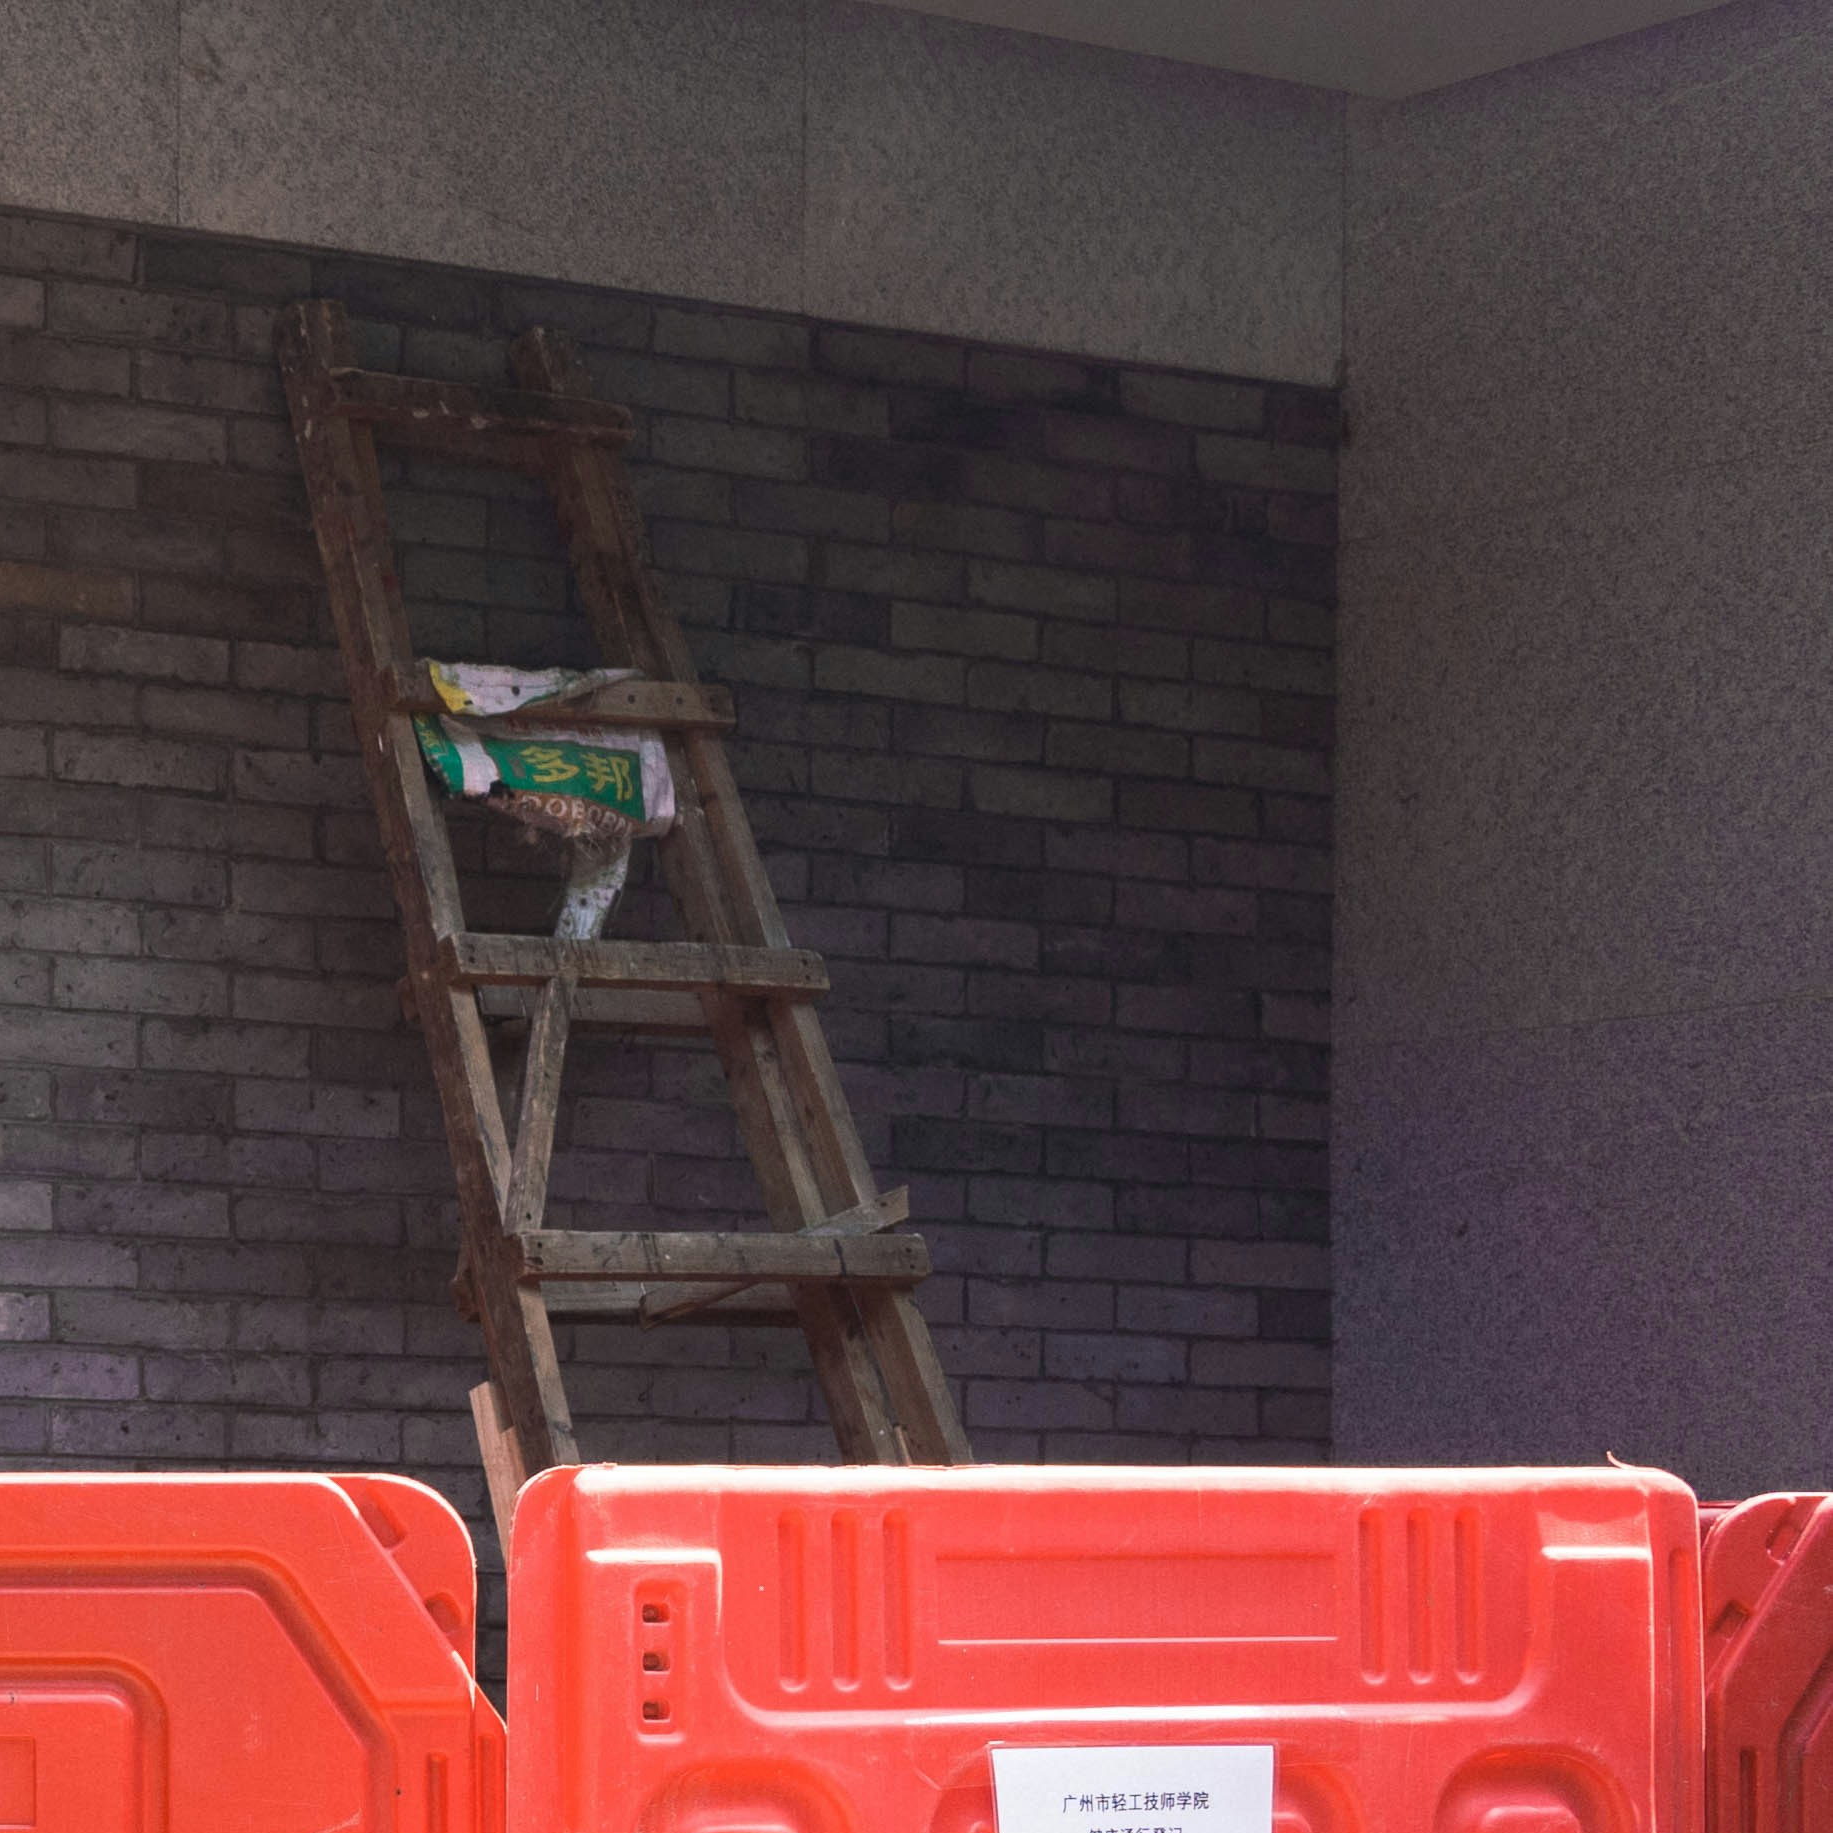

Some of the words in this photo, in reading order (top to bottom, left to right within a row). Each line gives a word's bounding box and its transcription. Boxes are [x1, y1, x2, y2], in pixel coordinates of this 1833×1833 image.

[1062, 1791, 1210, 1814] 广州市轻工技师学院
